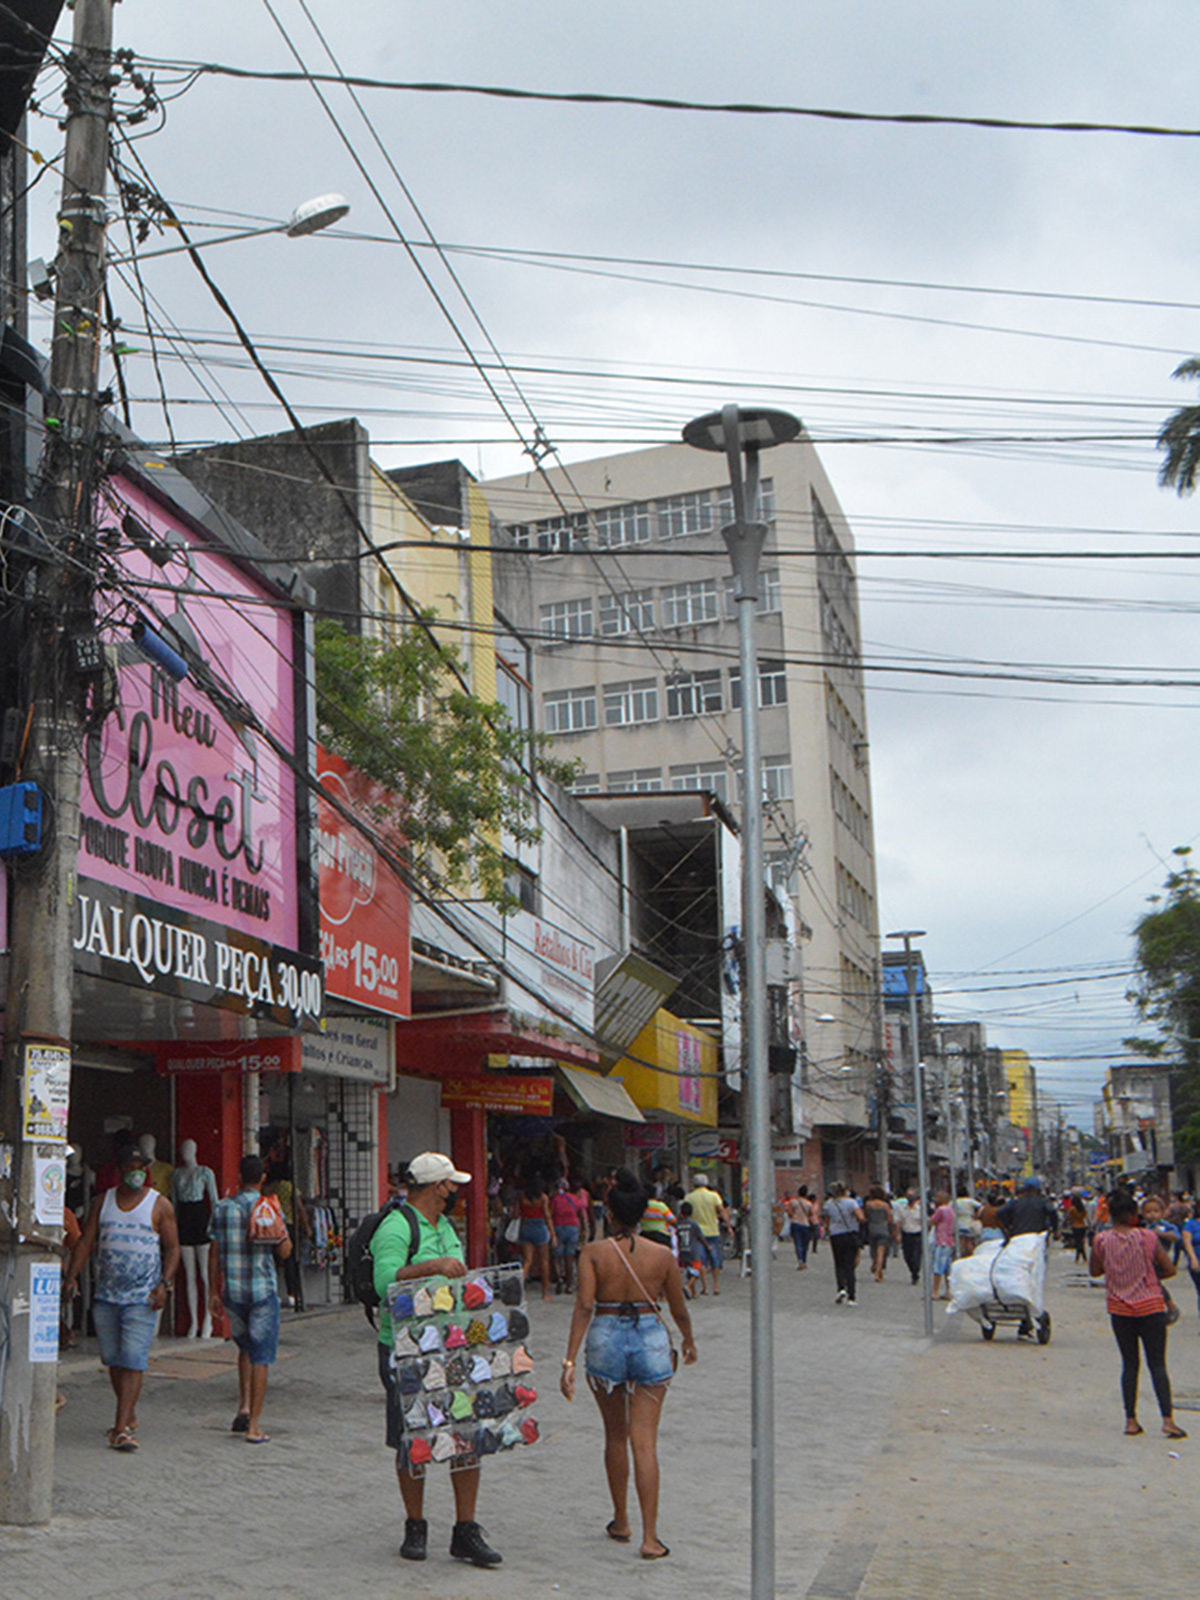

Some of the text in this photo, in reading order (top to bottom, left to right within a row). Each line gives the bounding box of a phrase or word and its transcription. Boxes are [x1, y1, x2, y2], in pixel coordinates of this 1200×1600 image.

[152, 666, 217, 748] Meu
[85, 709, 267, 875] Closet
[134, 836, 175, 887] ROUPA
[179, 856, 218, 904] NUNCA
[221, 866, 230, 907] É
[232, 876, 270, 922] DEMAIS
[214, 940, 276, 1008] PEÇA
[277, 961, 322, 1019] 30,00
